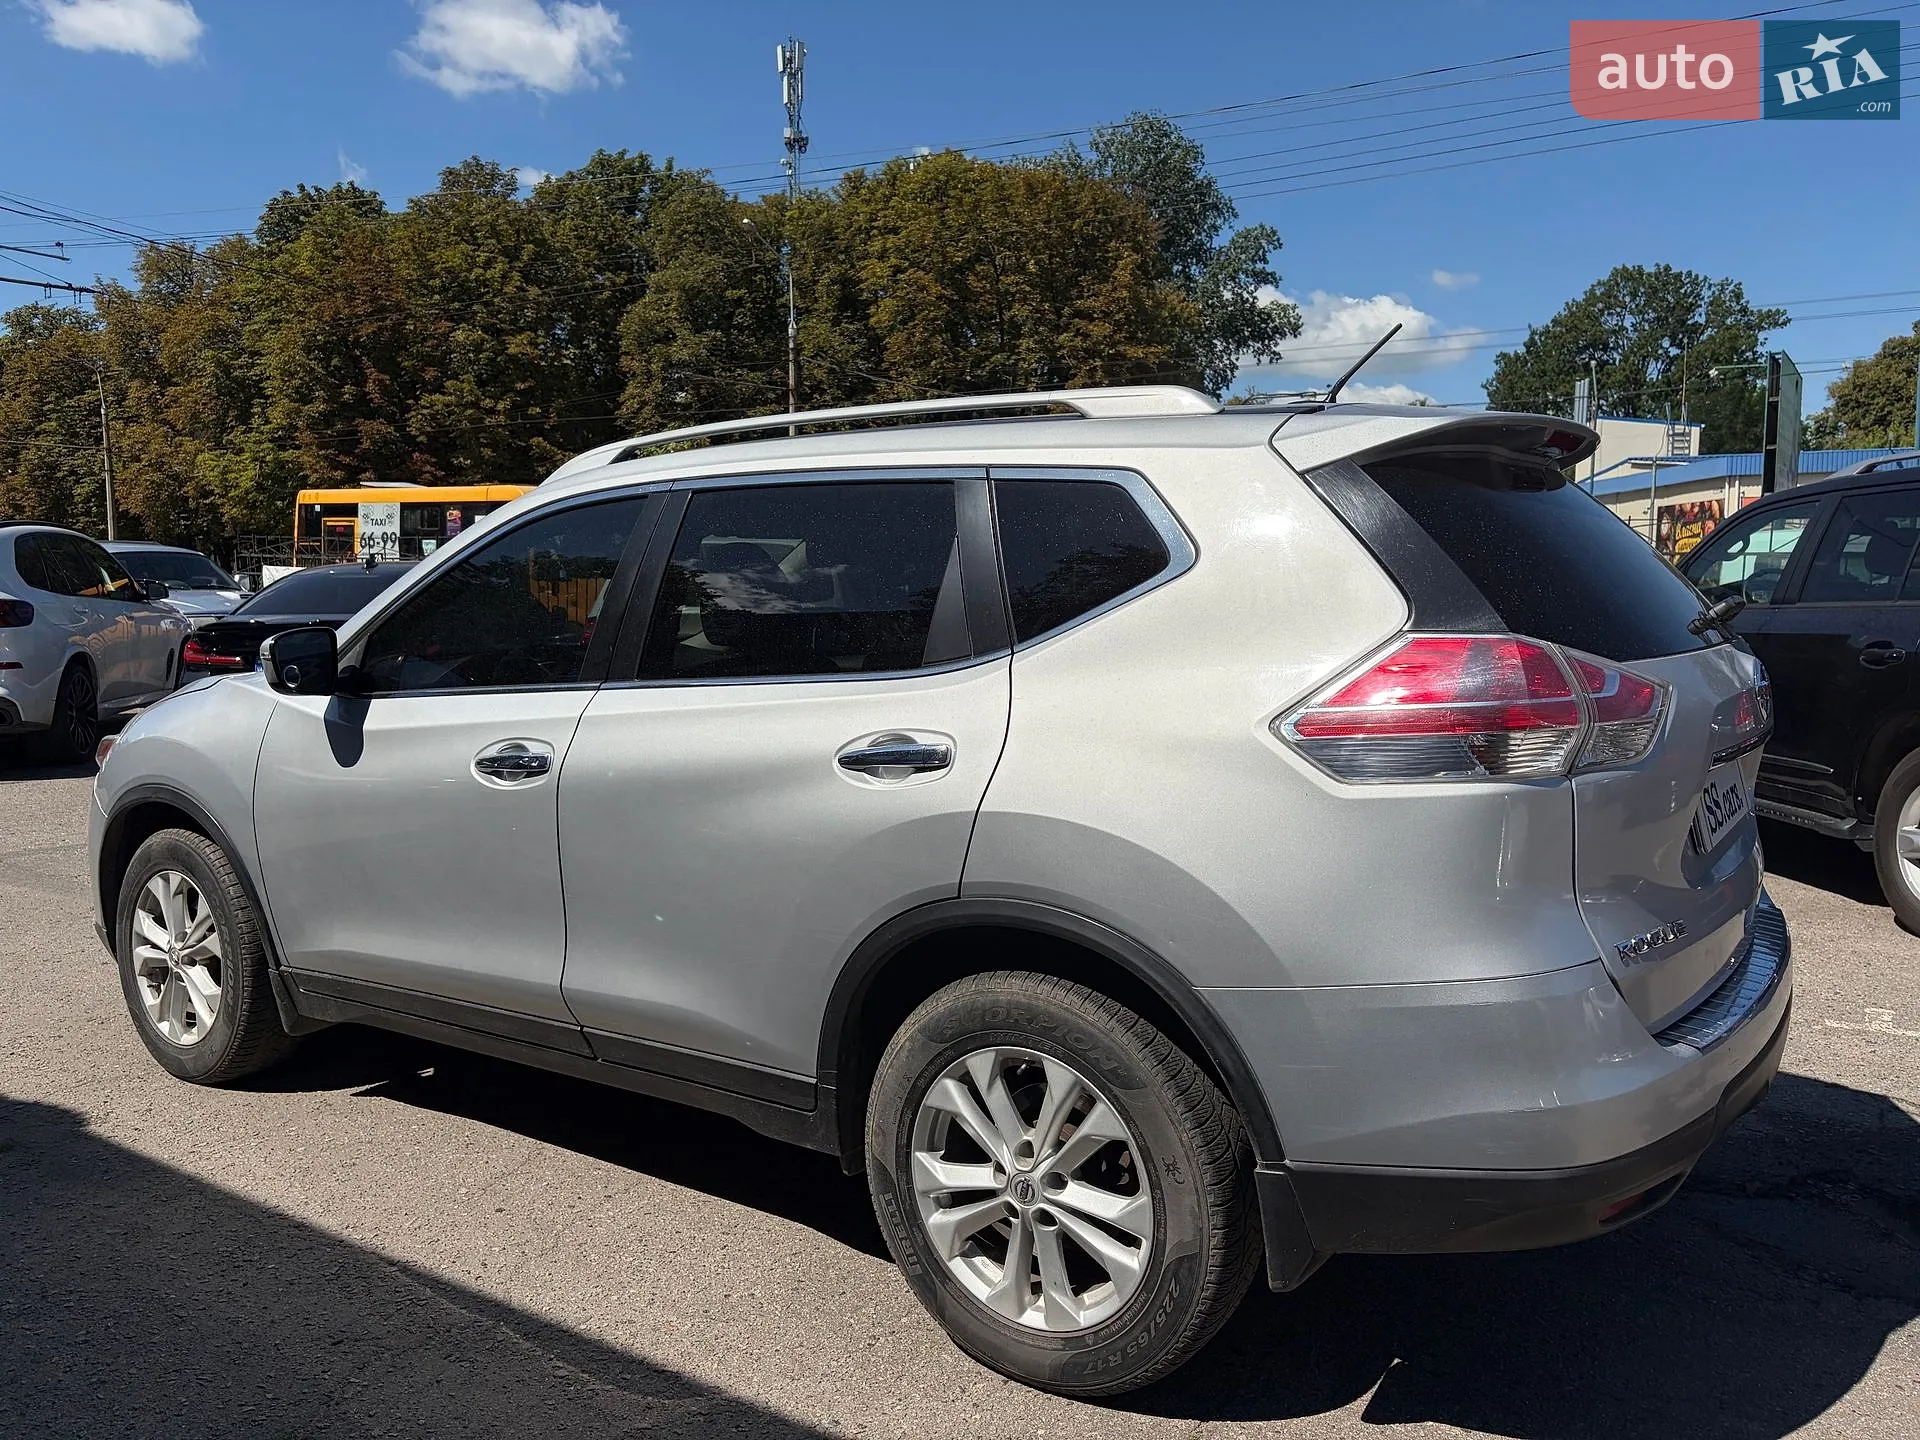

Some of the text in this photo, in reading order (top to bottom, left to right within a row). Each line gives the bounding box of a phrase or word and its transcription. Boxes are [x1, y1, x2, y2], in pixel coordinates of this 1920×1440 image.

[370, 518, 387, 526] TAXI
[360, 531, 398, 549] 66-99
[1613, 919, 1689, 962] ROGUE
[1126, 1277, 1180, 1358] 225/65
